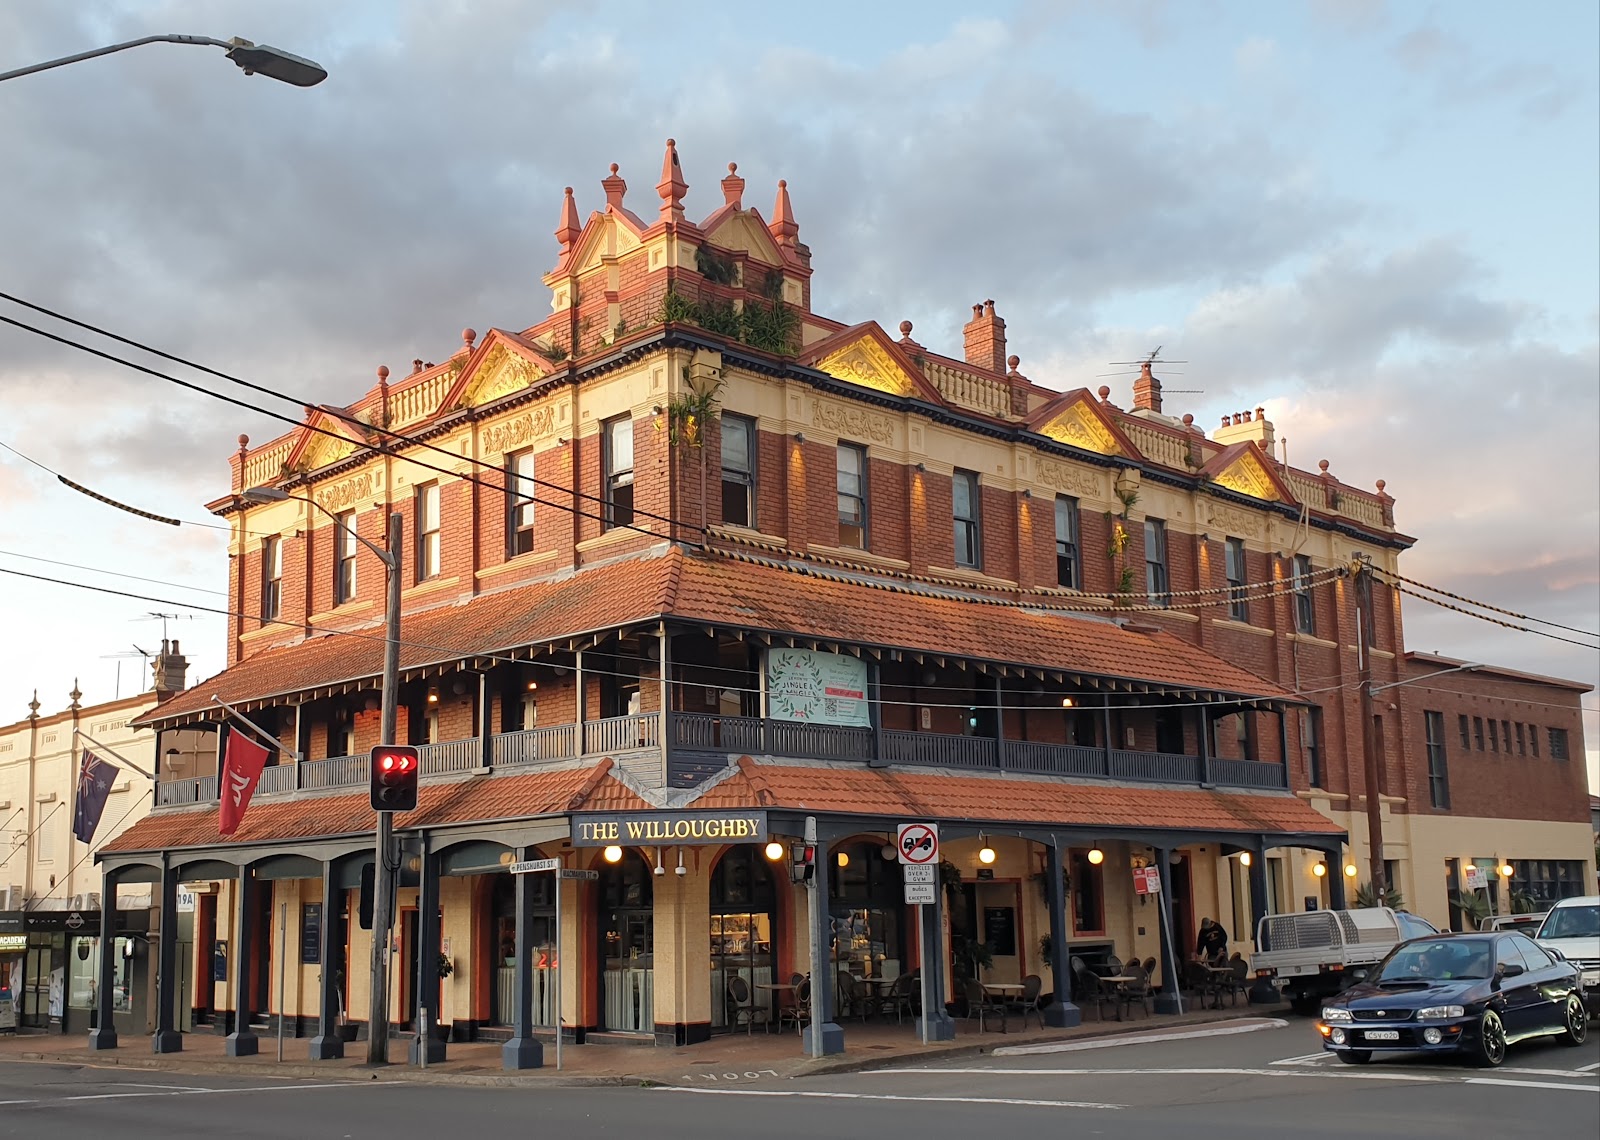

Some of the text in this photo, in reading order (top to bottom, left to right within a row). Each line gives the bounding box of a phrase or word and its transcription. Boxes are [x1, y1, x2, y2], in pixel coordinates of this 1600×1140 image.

[782, 681, 807, 689] JINGLE
[578, 818, 760, 840] THE WILLOUGHBY
[516, 859, 554, 871] PENSHURST ST
[587, 871, 593, 879] ST
[0, 936, 27, 944] ACADEMY
[699, 1069, 779, 1081] LOOK
